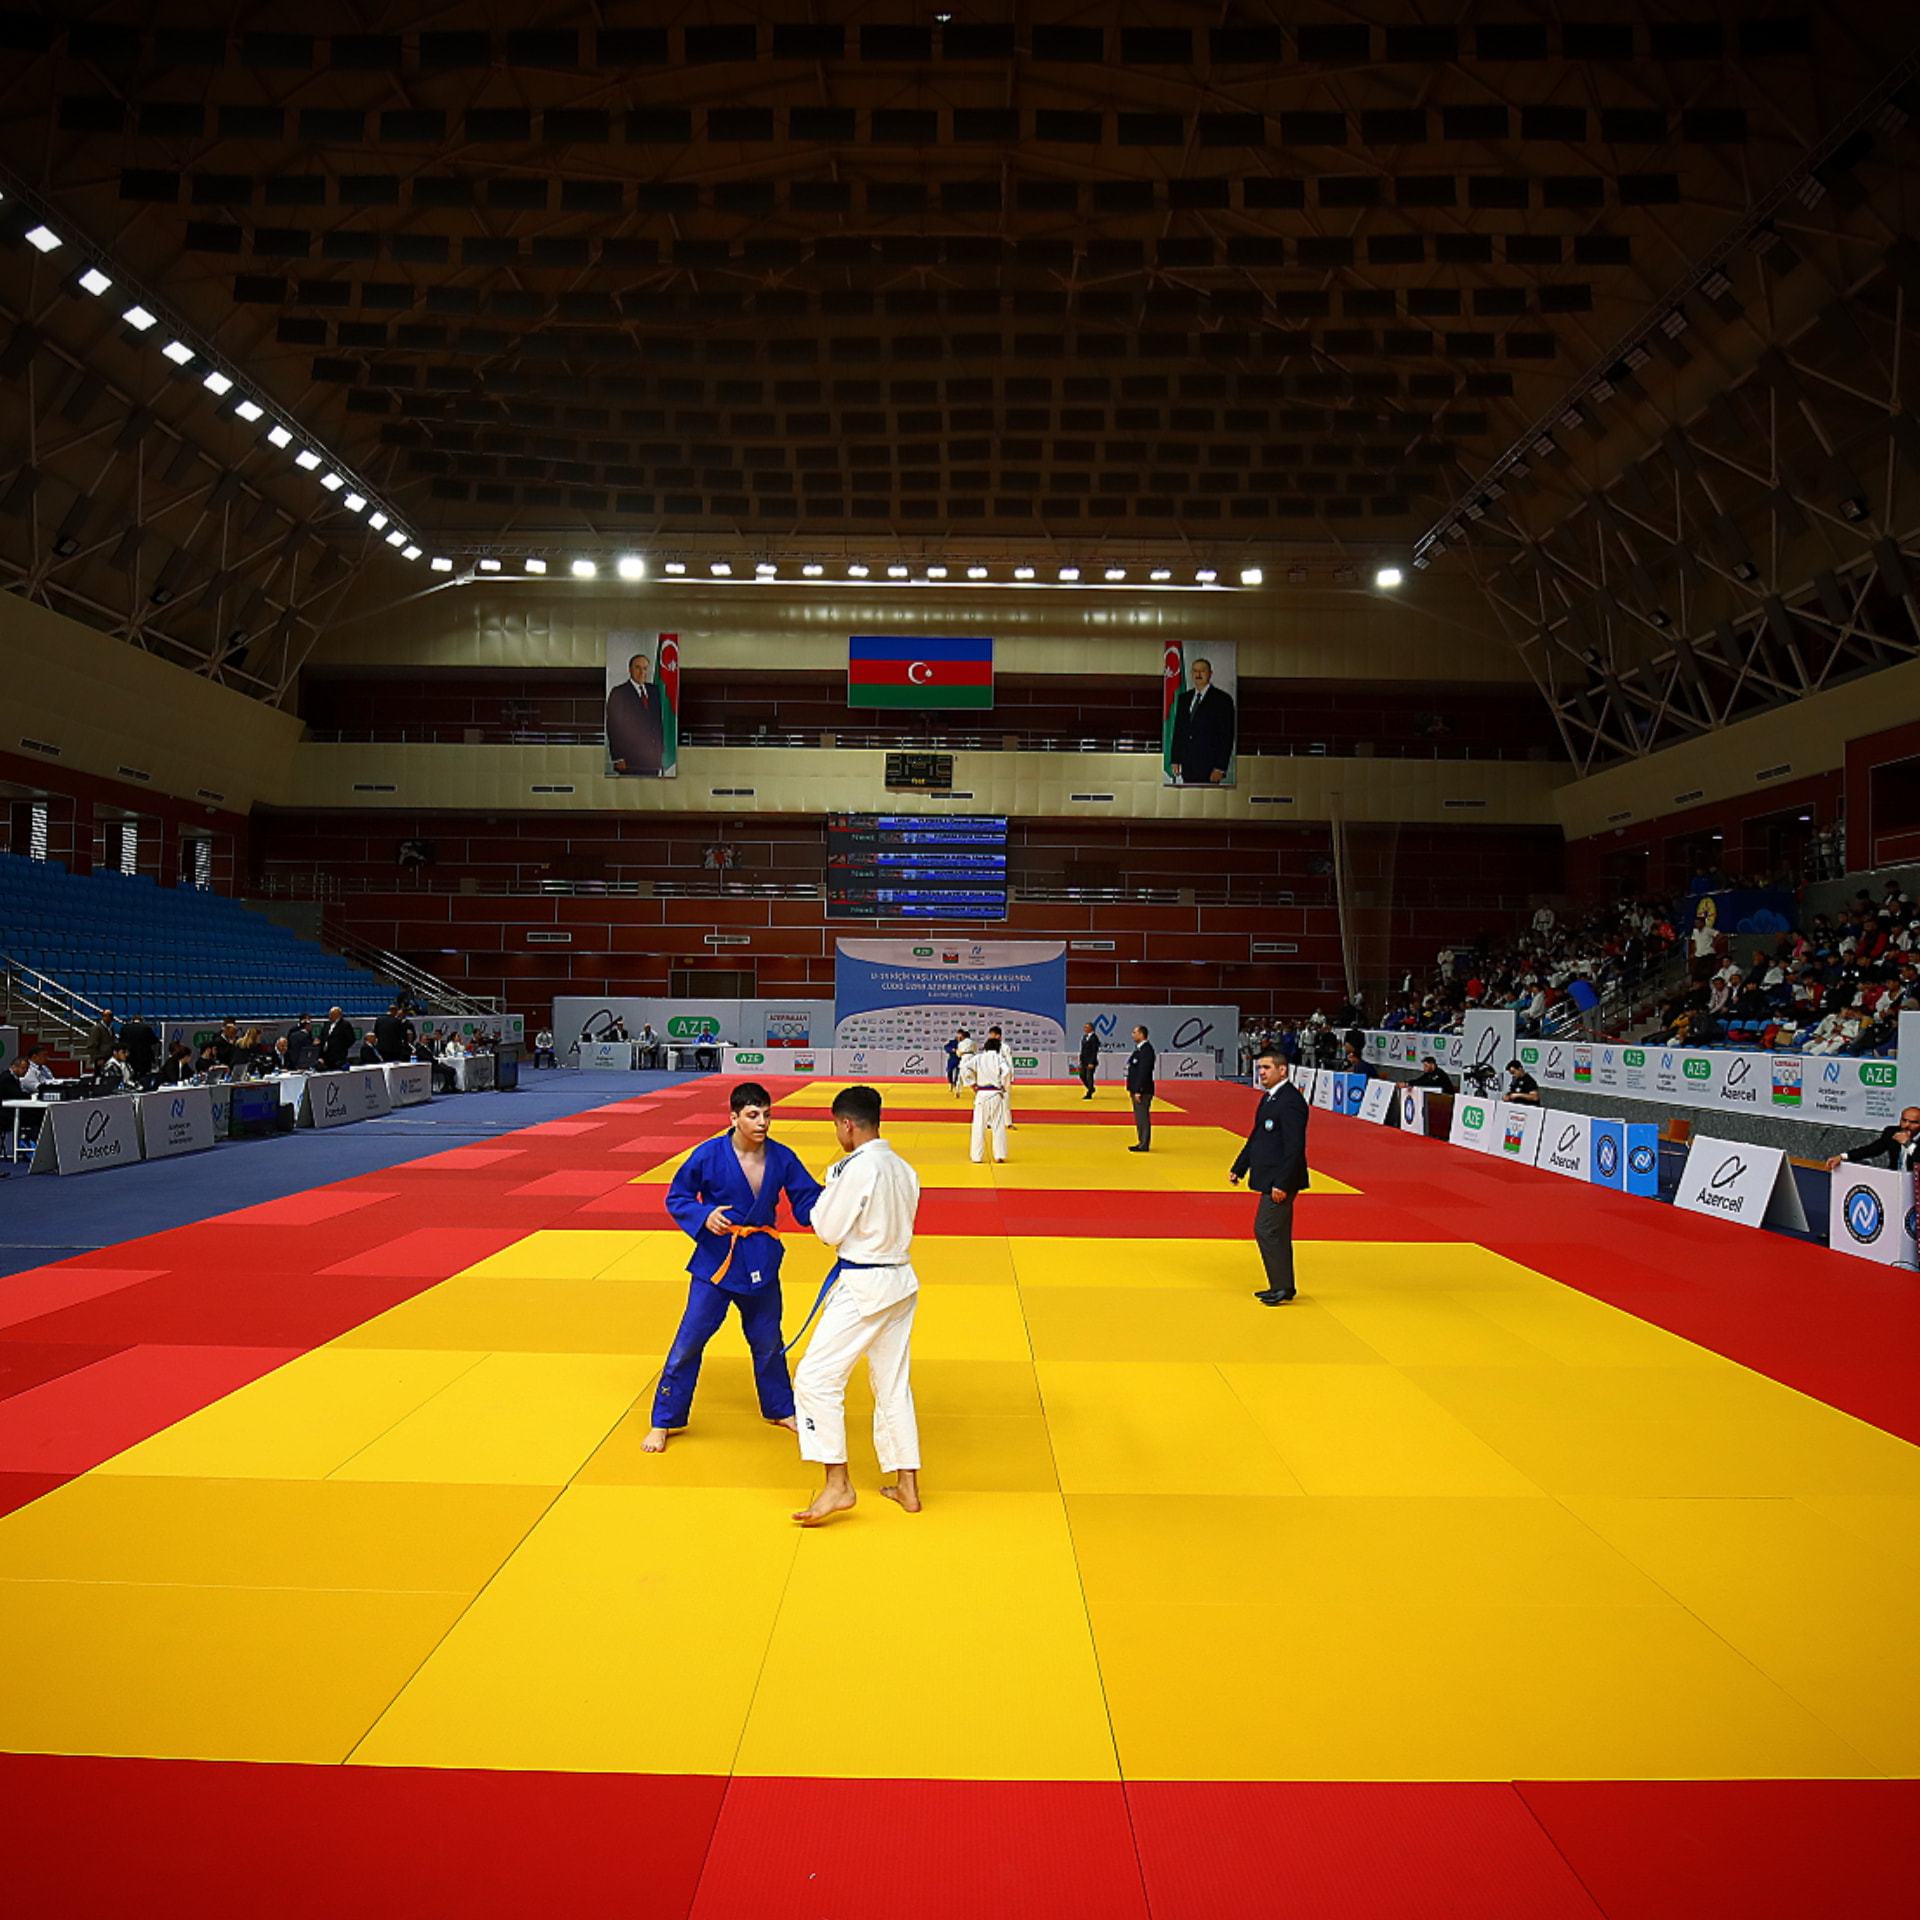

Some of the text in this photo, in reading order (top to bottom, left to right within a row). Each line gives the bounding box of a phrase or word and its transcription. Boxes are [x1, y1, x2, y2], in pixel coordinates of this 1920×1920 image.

[1687, 1061, 1707, 1076] AZE
[1866, 1068, 1893, 1083] AZE
[1720, 1086, 1756, 1102] Azercell
[80, 1139, 121, 1160] Azercell
[1696, 1188, 1744, 1213] Azercell
